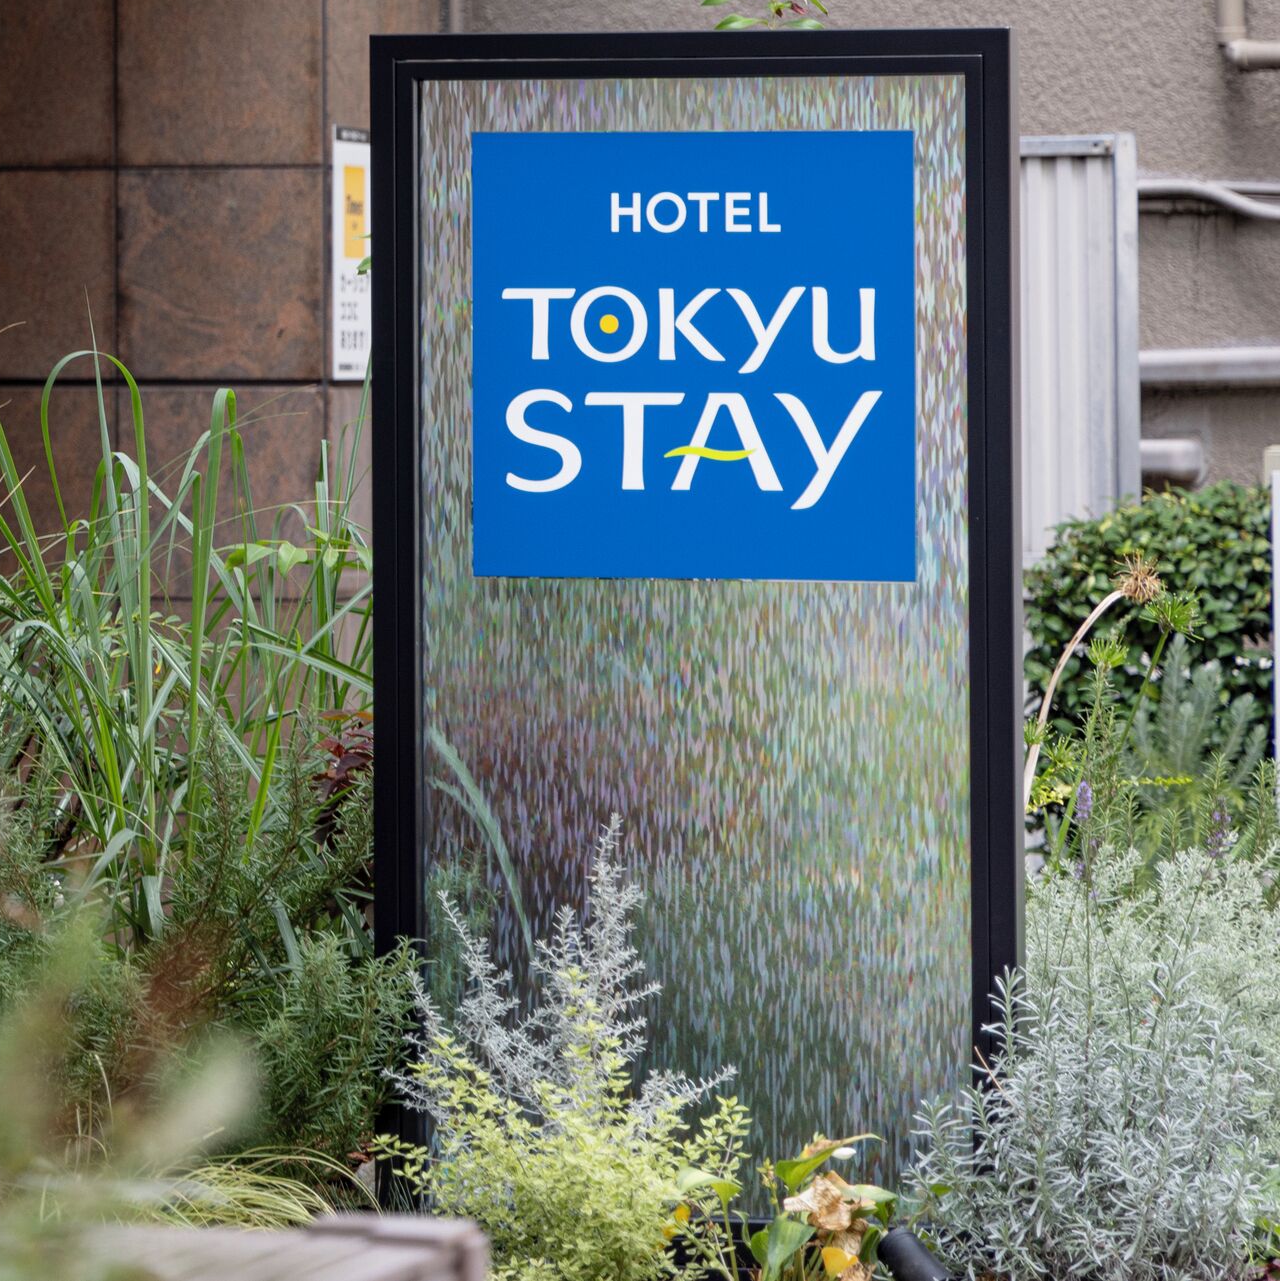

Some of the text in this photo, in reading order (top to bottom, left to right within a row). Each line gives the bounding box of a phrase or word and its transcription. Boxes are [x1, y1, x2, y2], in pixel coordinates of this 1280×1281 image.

[610, 191, 782, 234] HOTEL
[501, 285, 876, 375] TOKYU
[505, 388, 883, 510] STAY
